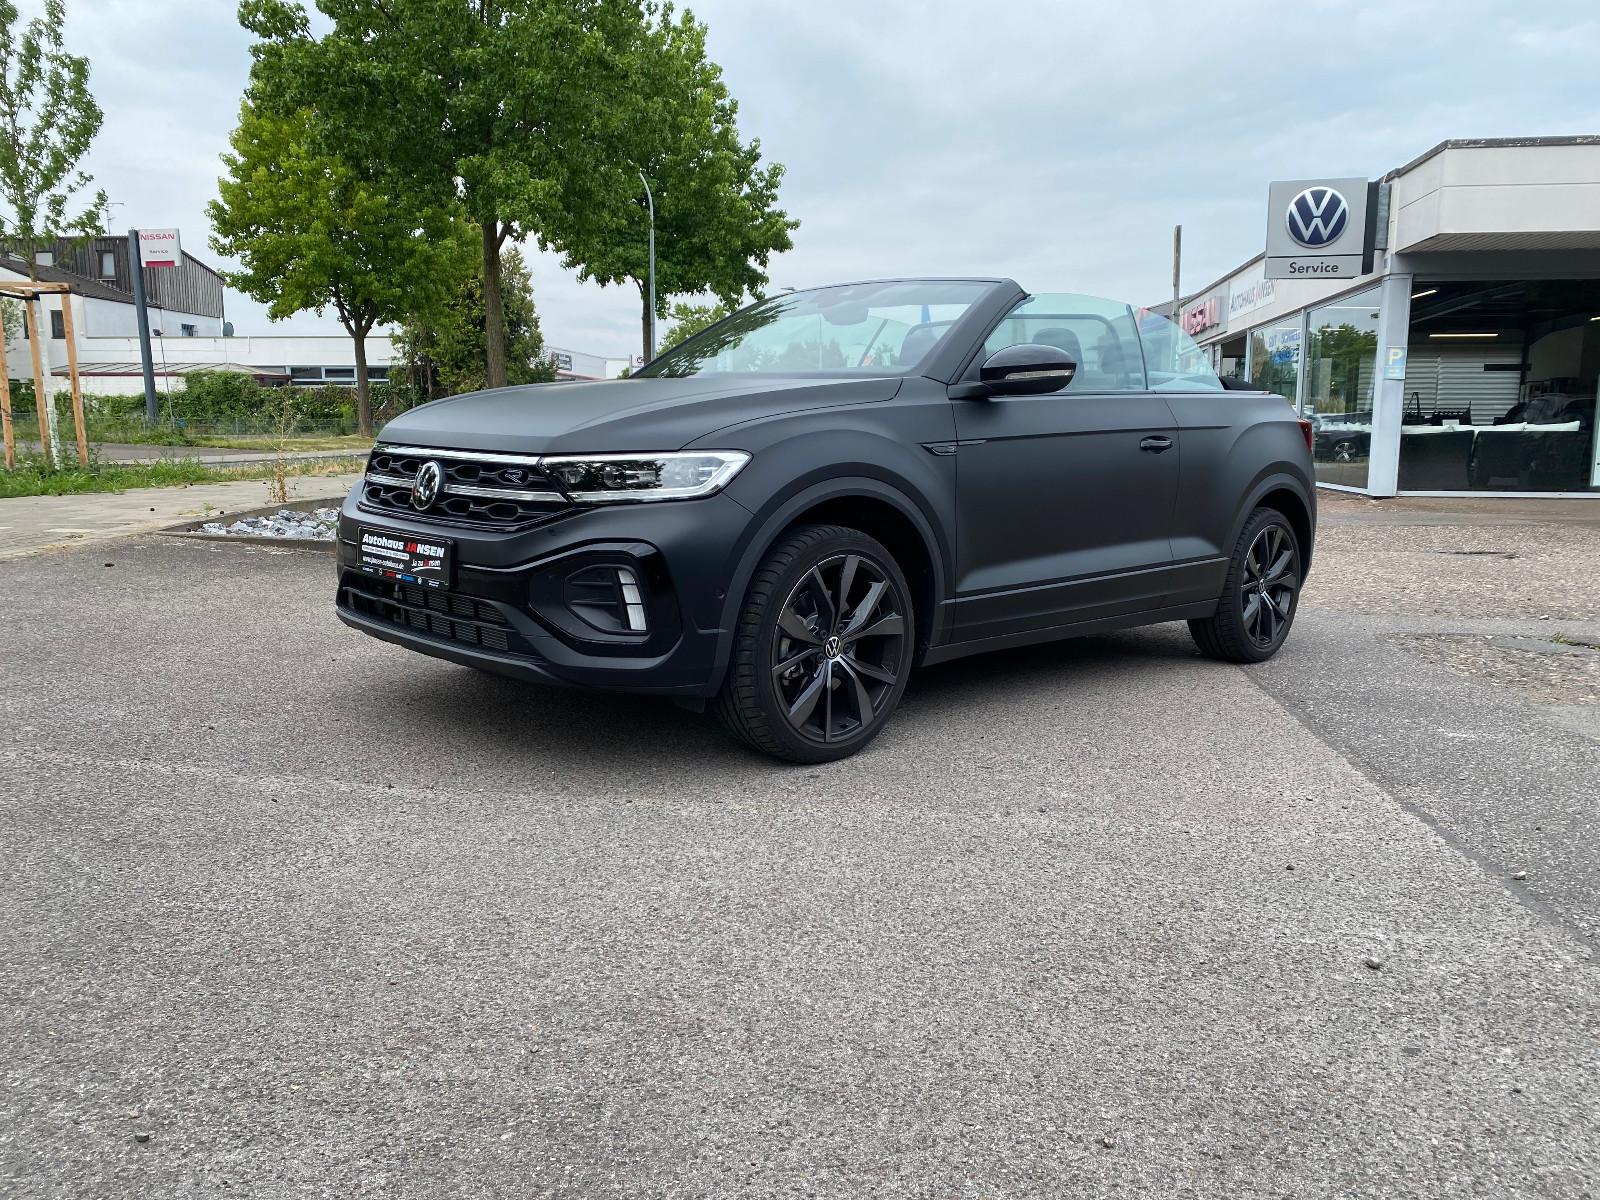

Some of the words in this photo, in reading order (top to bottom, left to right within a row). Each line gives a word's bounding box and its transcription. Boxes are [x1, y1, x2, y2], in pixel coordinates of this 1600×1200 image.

[1289, 262, 1339, 273] Service
[1389, 348, 1403, 365] P
[362, 534, 404, 550] Autohaus
[405, 540, 445, 558] JANSEN
